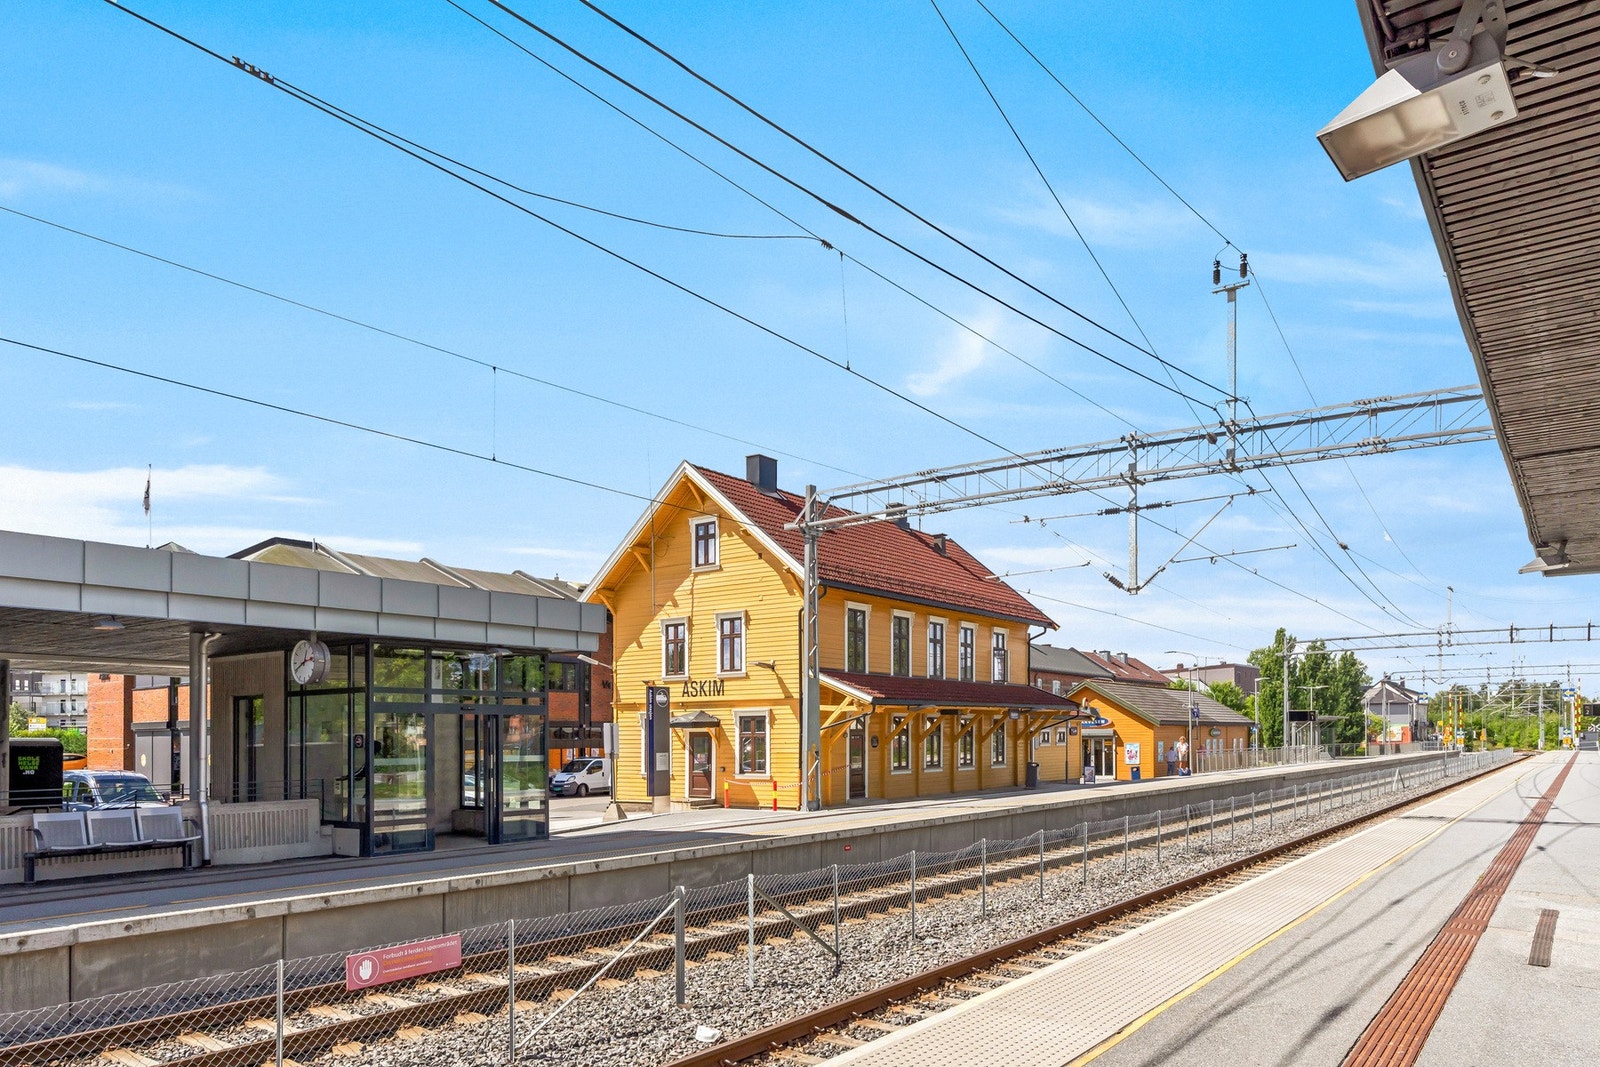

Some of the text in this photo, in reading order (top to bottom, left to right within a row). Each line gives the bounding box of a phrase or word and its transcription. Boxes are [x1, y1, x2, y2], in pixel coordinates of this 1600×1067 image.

[682, 680, 724, 697] ASKIM
[383, 951, 404, 960] Forbudt
[427, 940, 457, 950] sporområdet
